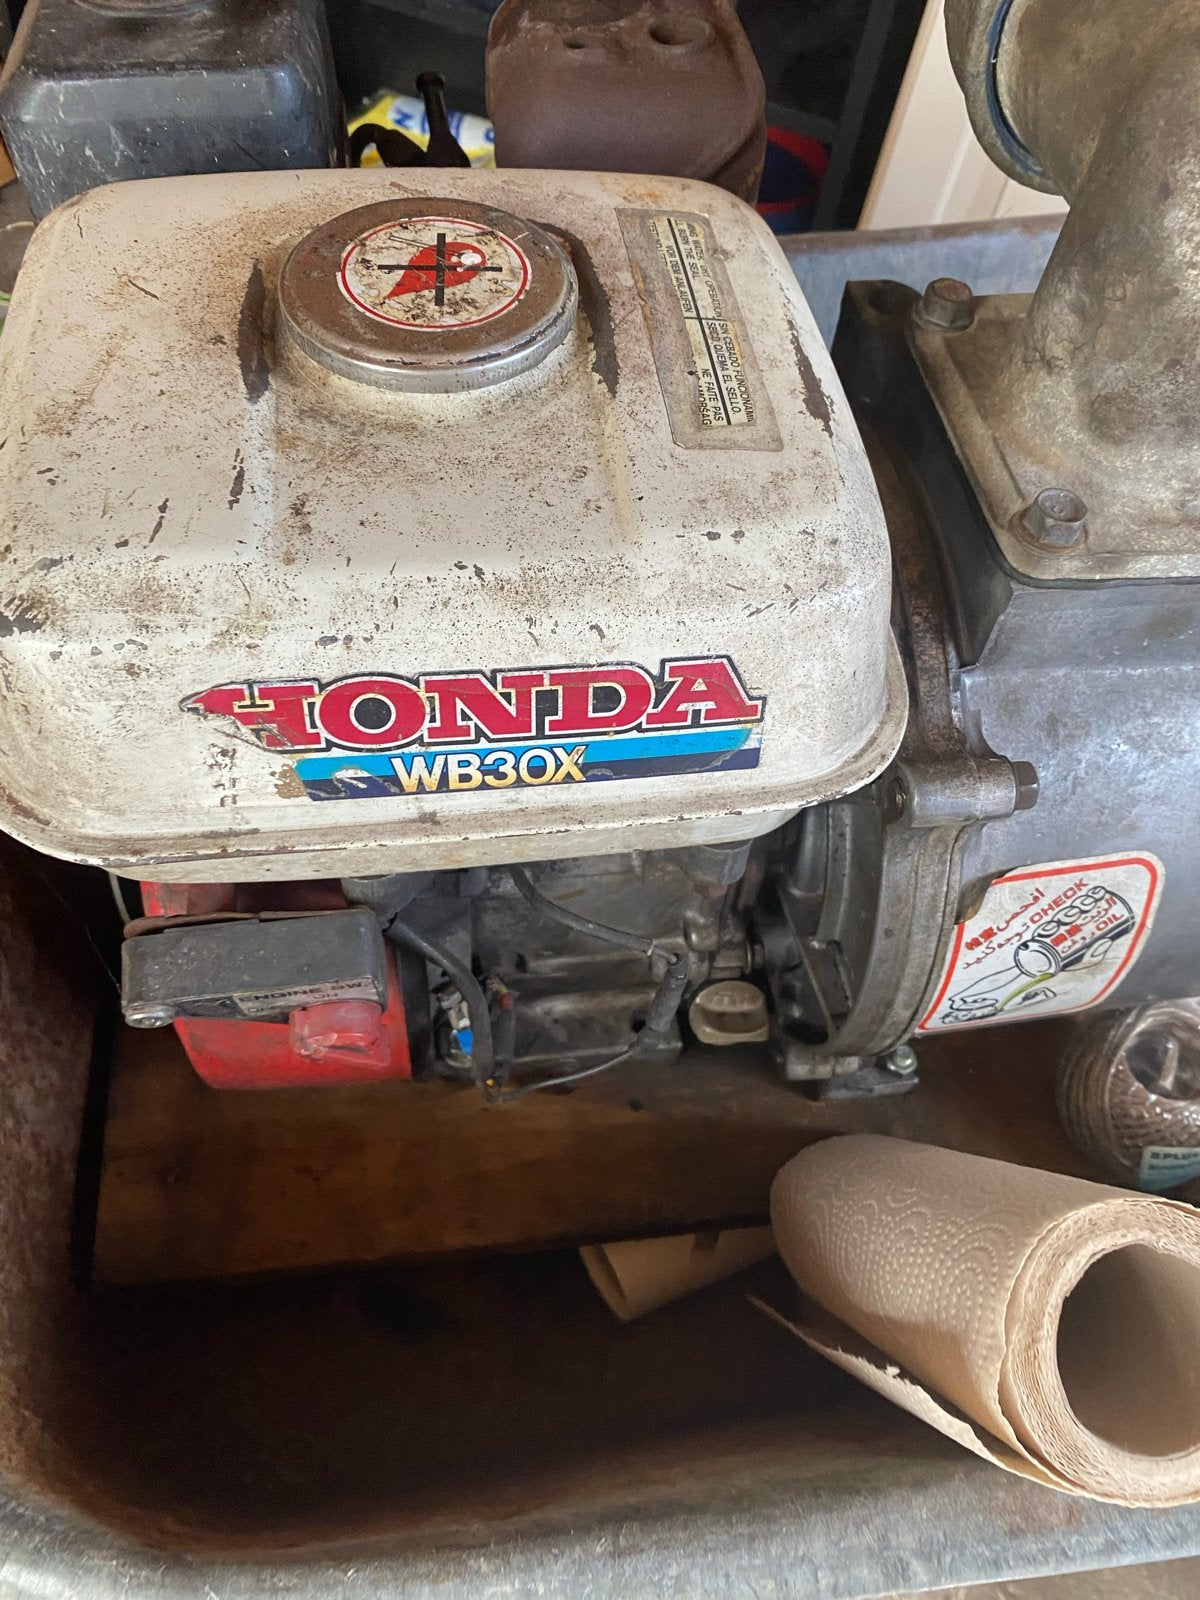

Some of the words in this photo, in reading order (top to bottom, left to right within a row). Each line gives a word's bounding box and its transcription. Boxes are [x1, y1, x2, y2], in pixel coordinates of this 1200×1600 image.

[665, 245, 677, 258] VOR
[678, 228, 690, 245] BURN
[684, 247, 696, 260] THE
[669, 260, 682, 274] DEM
[674, 276, 694, 313] ANLAUFEN
[719, 322, 730, 335] SIN
[714, 345, 730, 371] QUEMA
[723, 337, 741, 368] CEBADO
[701, 368, 712, 379] NE
[722, 374, 733, 384] EL
[704, 381, 719, 402] FAITE
[725, 386, 742, 415] SELLO.
[710, 406, 724, 422] PAS
[188, 658, 764, 751] HONDA
[390, 744, 589, 793] WB30X
[1029, 878, 1089, 924] CHECK
[1095, 913, 1125, 932] OIL
[238, 987, 325, 1002] ENGINE
